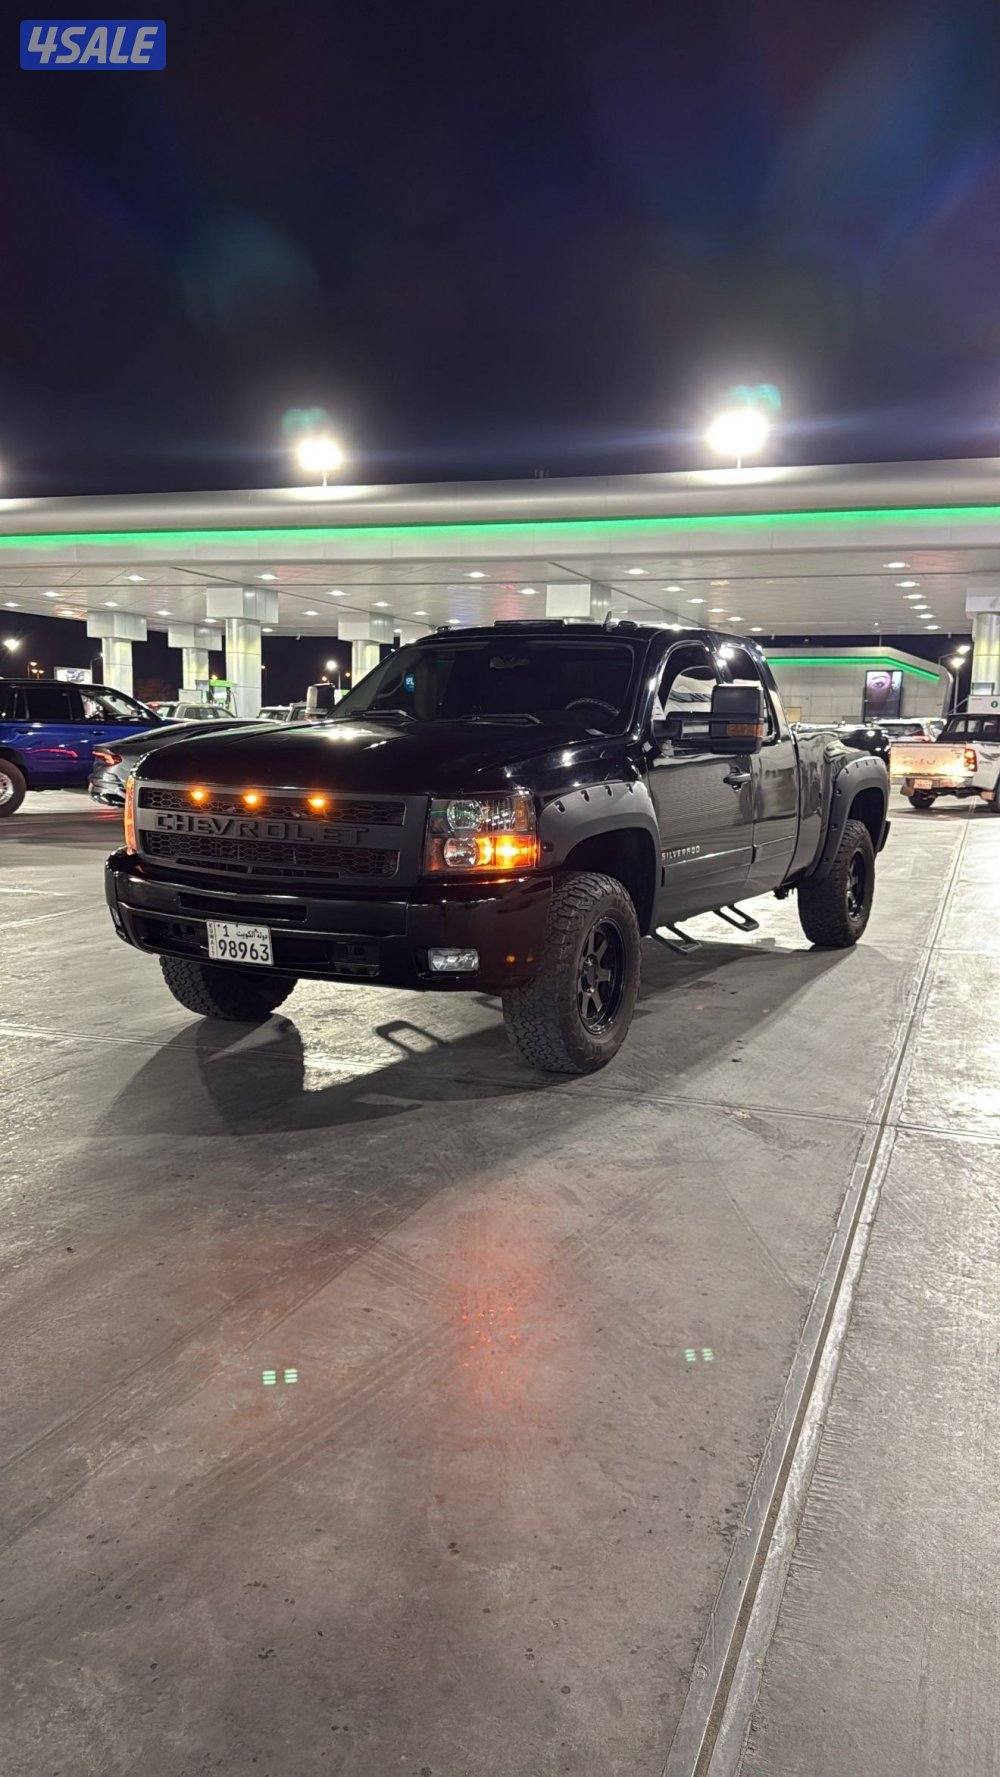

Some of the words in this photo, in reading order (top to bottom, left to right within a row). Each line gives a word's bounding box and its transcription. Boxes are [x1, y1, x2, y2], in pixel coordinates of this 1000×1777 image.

[155, 812, 369, 845] CHEVROLET
[661, 845, 700, 860] SILVERADO
[223, 924, 229, 938] 1
[236, 928, 257, 939] الكويت
[219, 939, 269, 961] 98963
